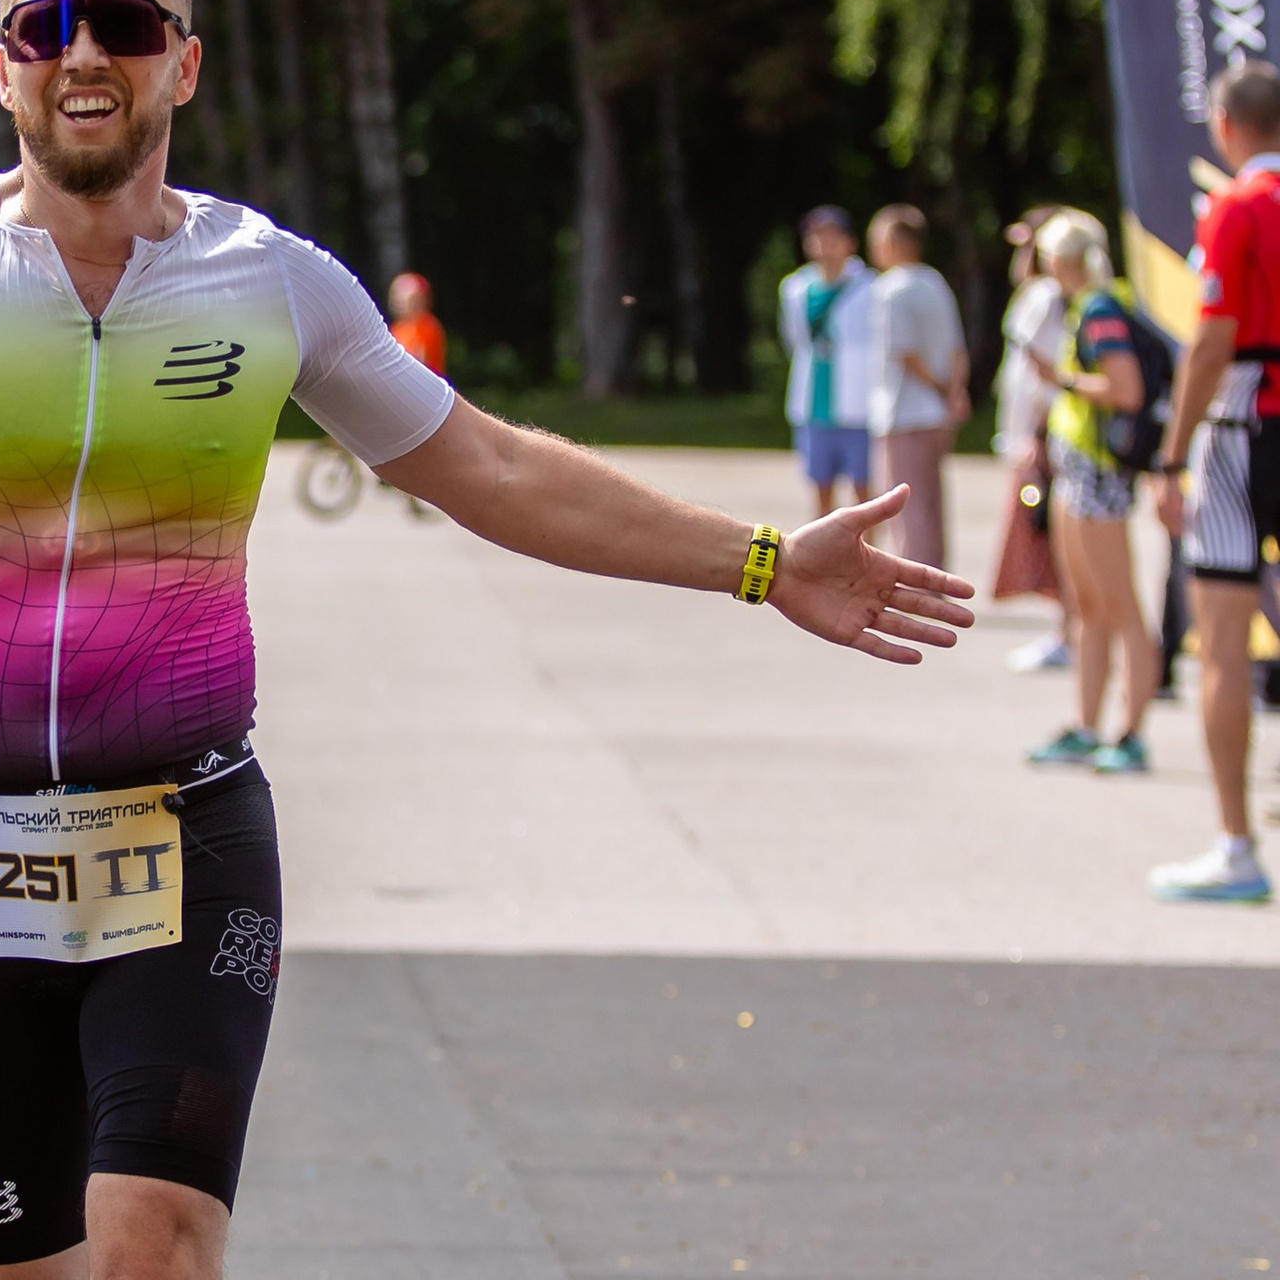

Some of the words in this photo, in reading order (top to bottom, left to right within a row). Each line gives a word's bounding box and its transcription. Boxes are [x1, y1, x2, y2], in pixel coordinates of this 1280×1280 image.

[67, 801, 157, 824] ТРИАТЛОН
[22, 826, 48, 834] СПРИНТ
[61, 824, 93, 832] АВГУСТА
[102, 921, 165, 940] SWIMSUPRUN
